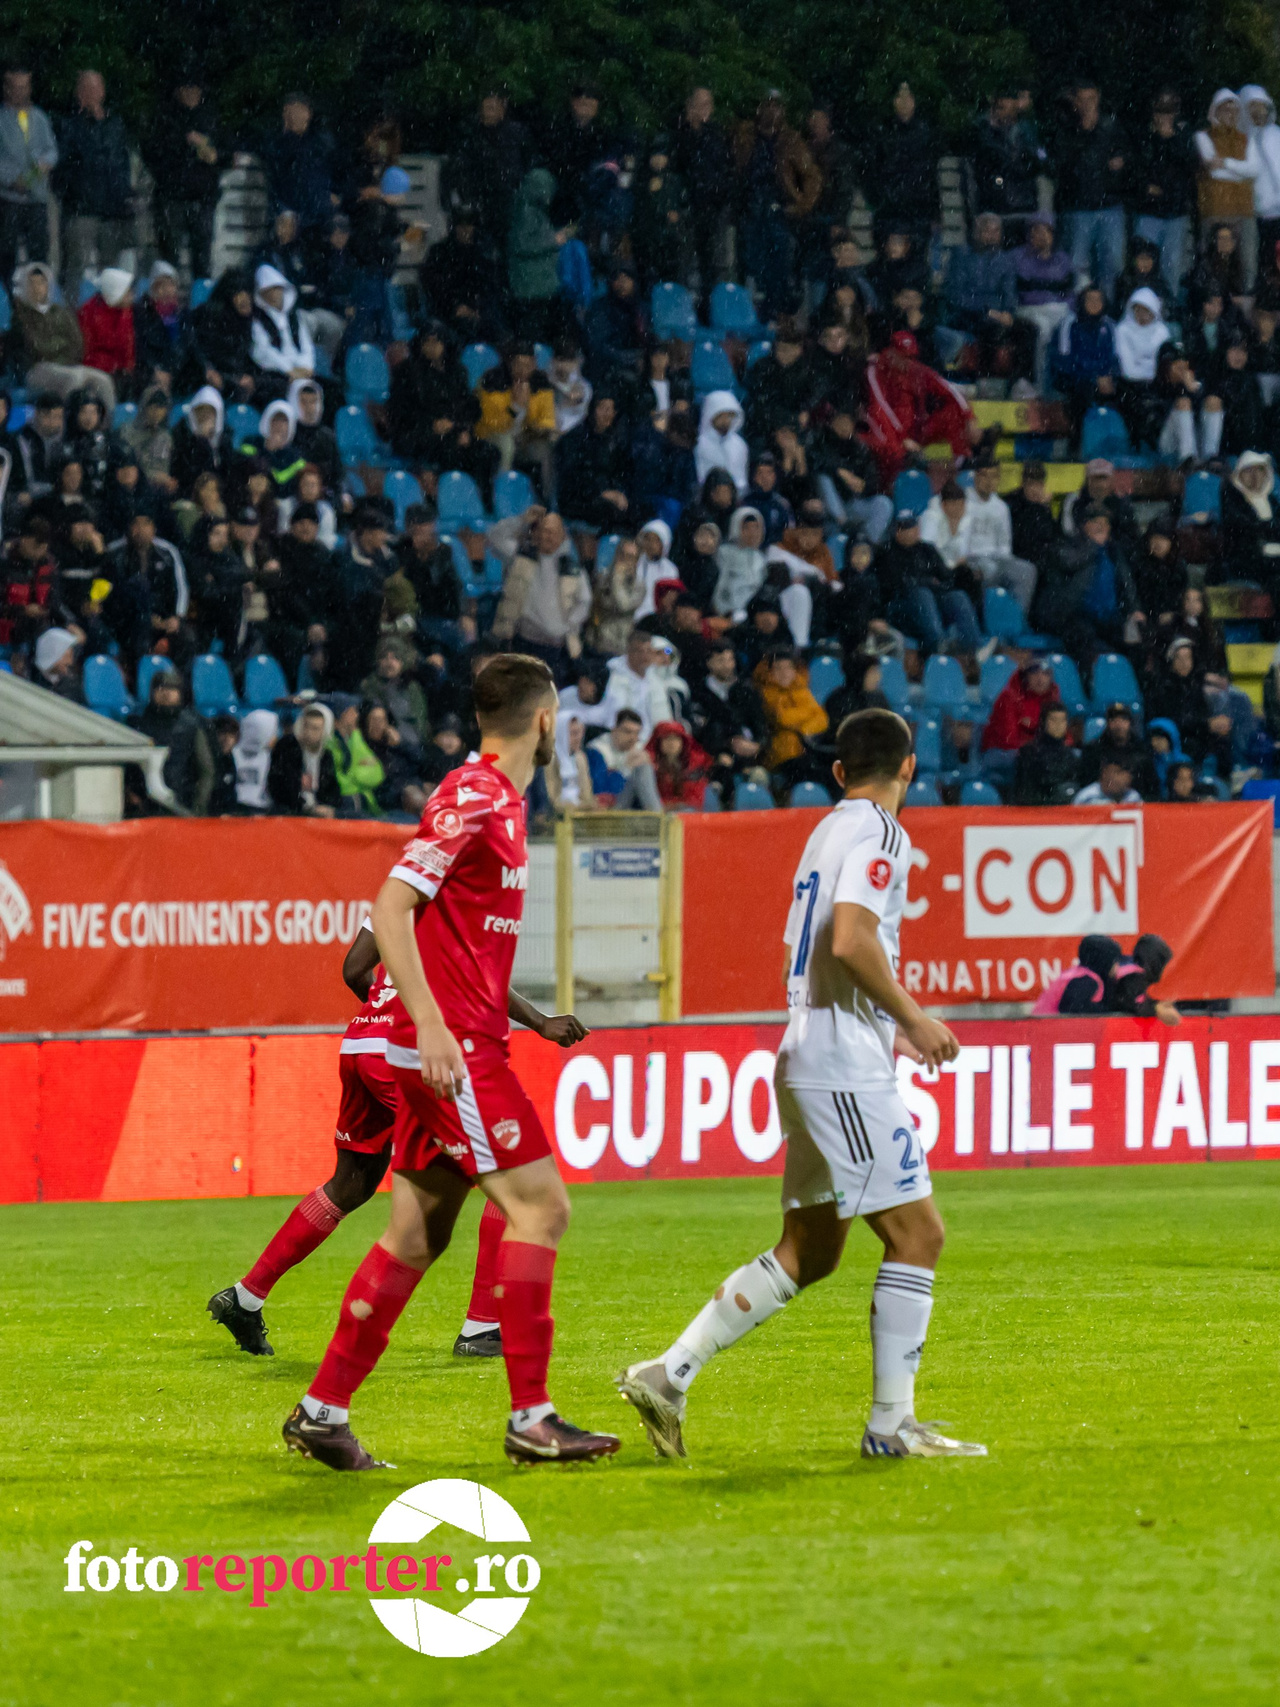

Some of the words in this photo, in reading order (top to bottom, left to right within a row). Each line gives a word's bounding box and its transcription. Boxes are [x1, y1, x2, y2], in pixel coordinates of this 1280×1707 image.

[43, 903, 106, 949] FIVE
[110, 901, 271, 947] CONTINENTS
[794, 871, 820, 976] 7
[554, 1051, 666, 1170] CU
